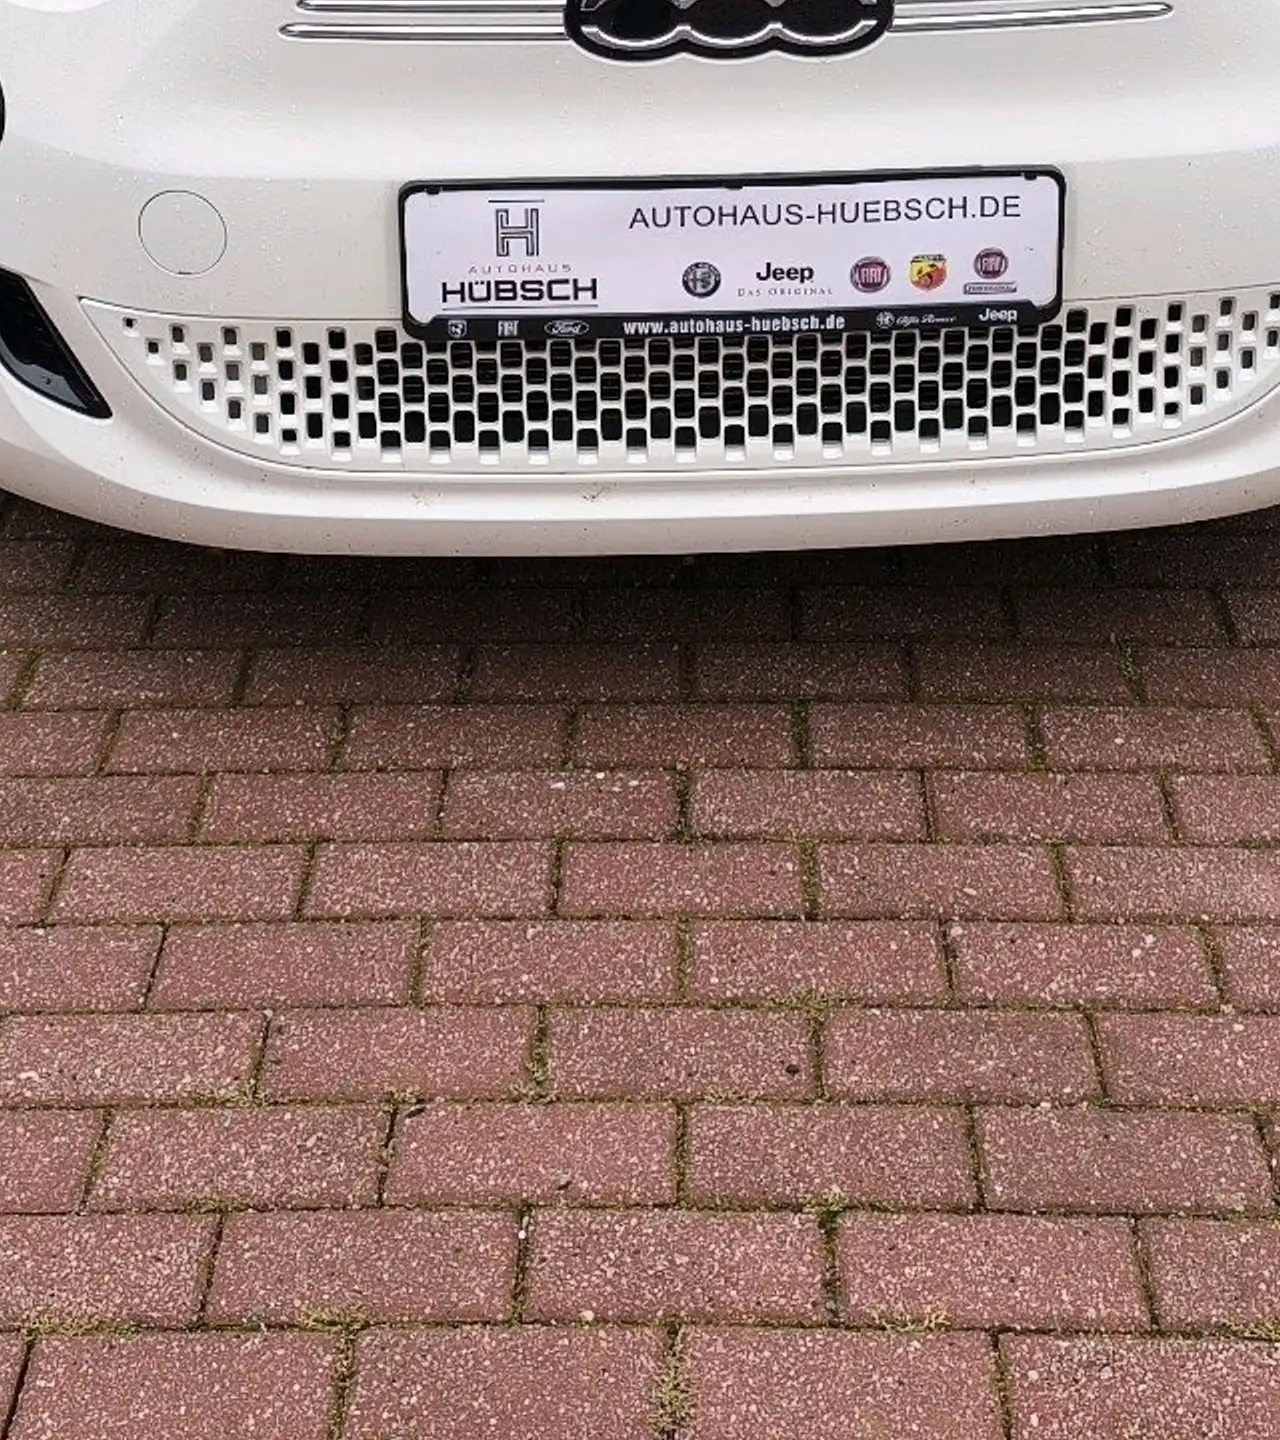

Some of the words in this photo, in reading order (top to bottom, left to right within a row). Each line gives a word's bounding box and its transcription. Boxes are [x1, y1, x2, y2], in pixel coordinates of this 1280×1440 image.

[628, 195, 1022, 230] AUTOHAUS-HUEBSCH.DE
[468, 263, 572, 275] AUTOHAUS
[756, 262, 815, 284] Jeep
[441, 277, 599, 304] HÜBSCH
[623, 314, 846, 336] www.autohaus-huebsch.de
[978, 307, 1018, 323] Jeep
